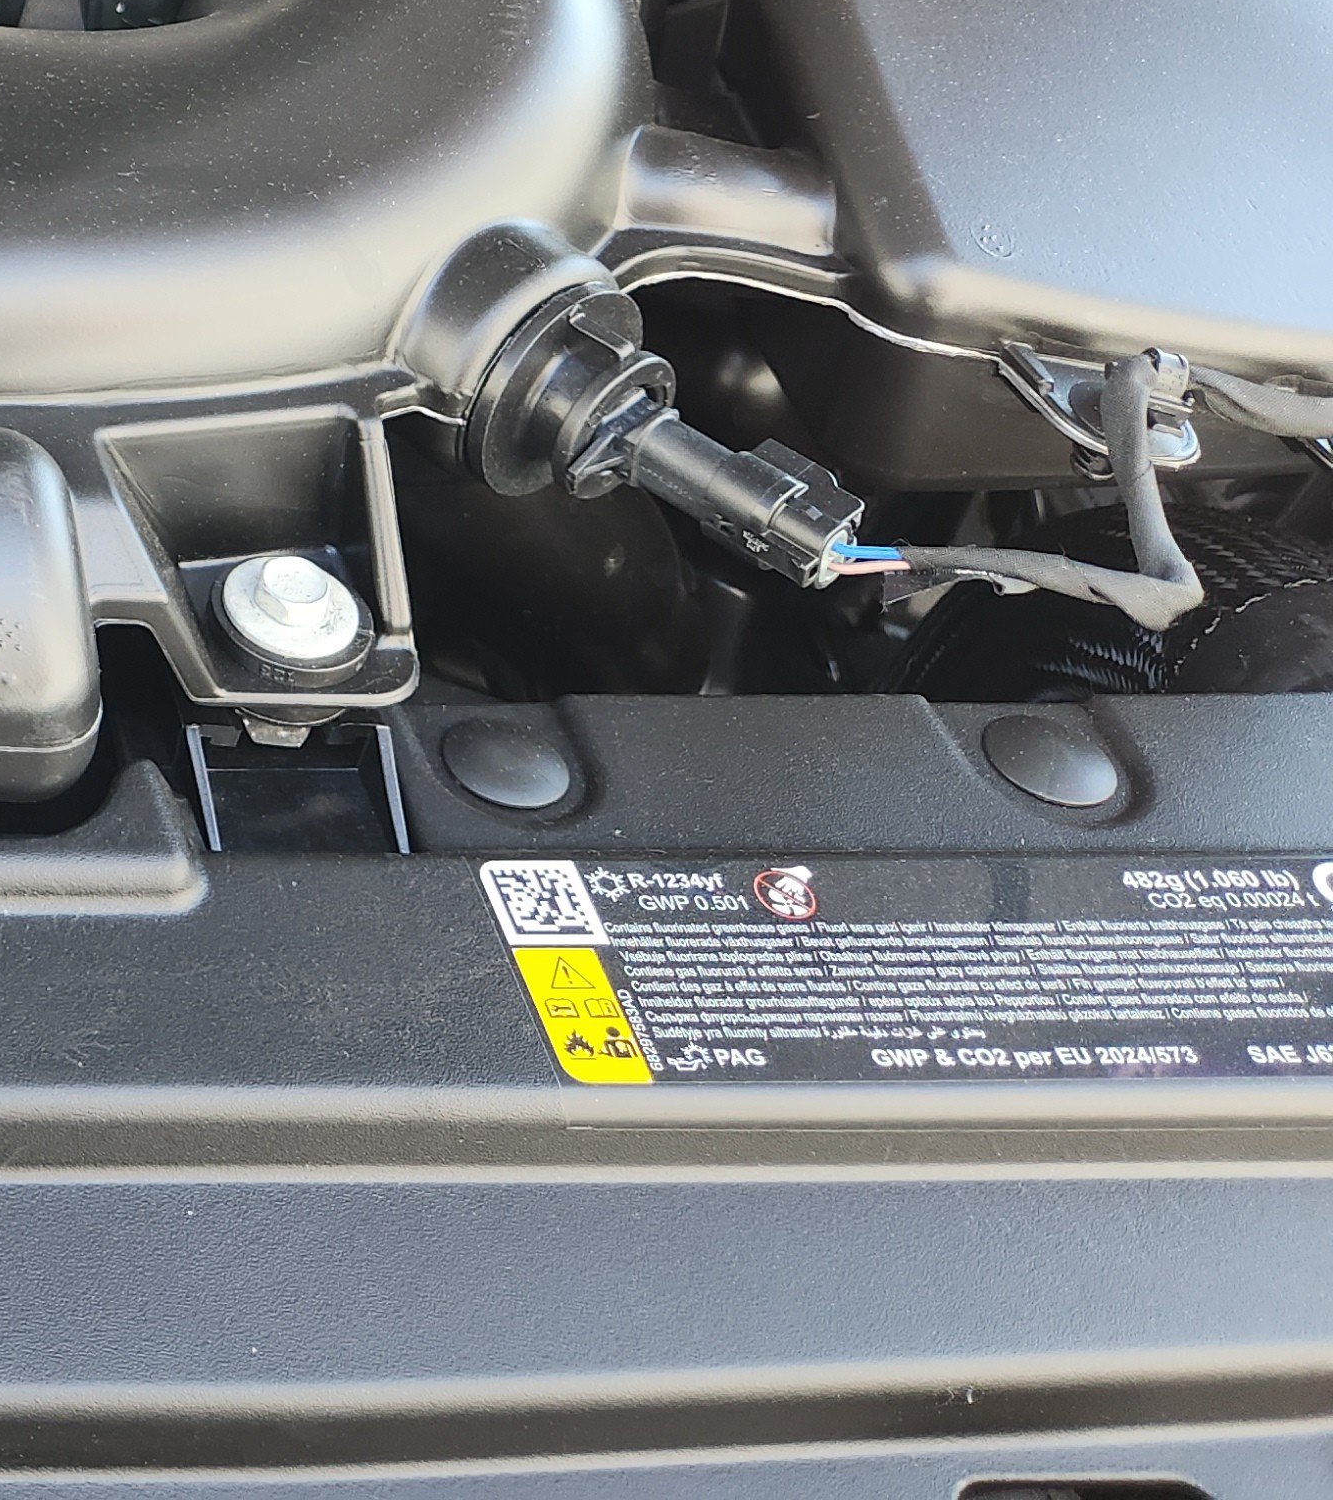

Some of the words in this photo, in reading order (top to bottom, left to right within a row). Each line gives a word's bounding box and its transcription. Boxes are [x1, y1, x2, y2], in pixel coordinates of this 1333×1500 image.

[626, 872, 725, 892] R-1234yf
[1122, 870, 1186, 892] 482g
[1182, 870, 1261, 892] (1.060
[1260, 869, 1301, 891] lb)
[637, 894, 691, 911] GWP
[693, 894, 750, 911] 0.501
[1147, 892, 1197, 909] CO2
[1197, 896, 1228, 911] eq
[1224, 891, 1306, 908] 0.00024
[1306, 891, 1321, 907] t
[603, 922, 653, 932] Contains
[652, 922, 711, 932] fluorinated
[711, 921, 775, 934] greenhouse
[776, 924, 810, 934] gases
[712, 1048, 768, 1067] PAG
[871, 1047, 930, 1068] GWP
[933, 1046, 956, 1066] &
[961, 1046, 1013, 1066] CO2
[1015, 1050, 1053, 1070] per
[1054, 1046, 1091, 1067] EU
[1094, 1045, 1200, 1066] 2024/573
[1246, 1044, 1302, 1064] SAE
